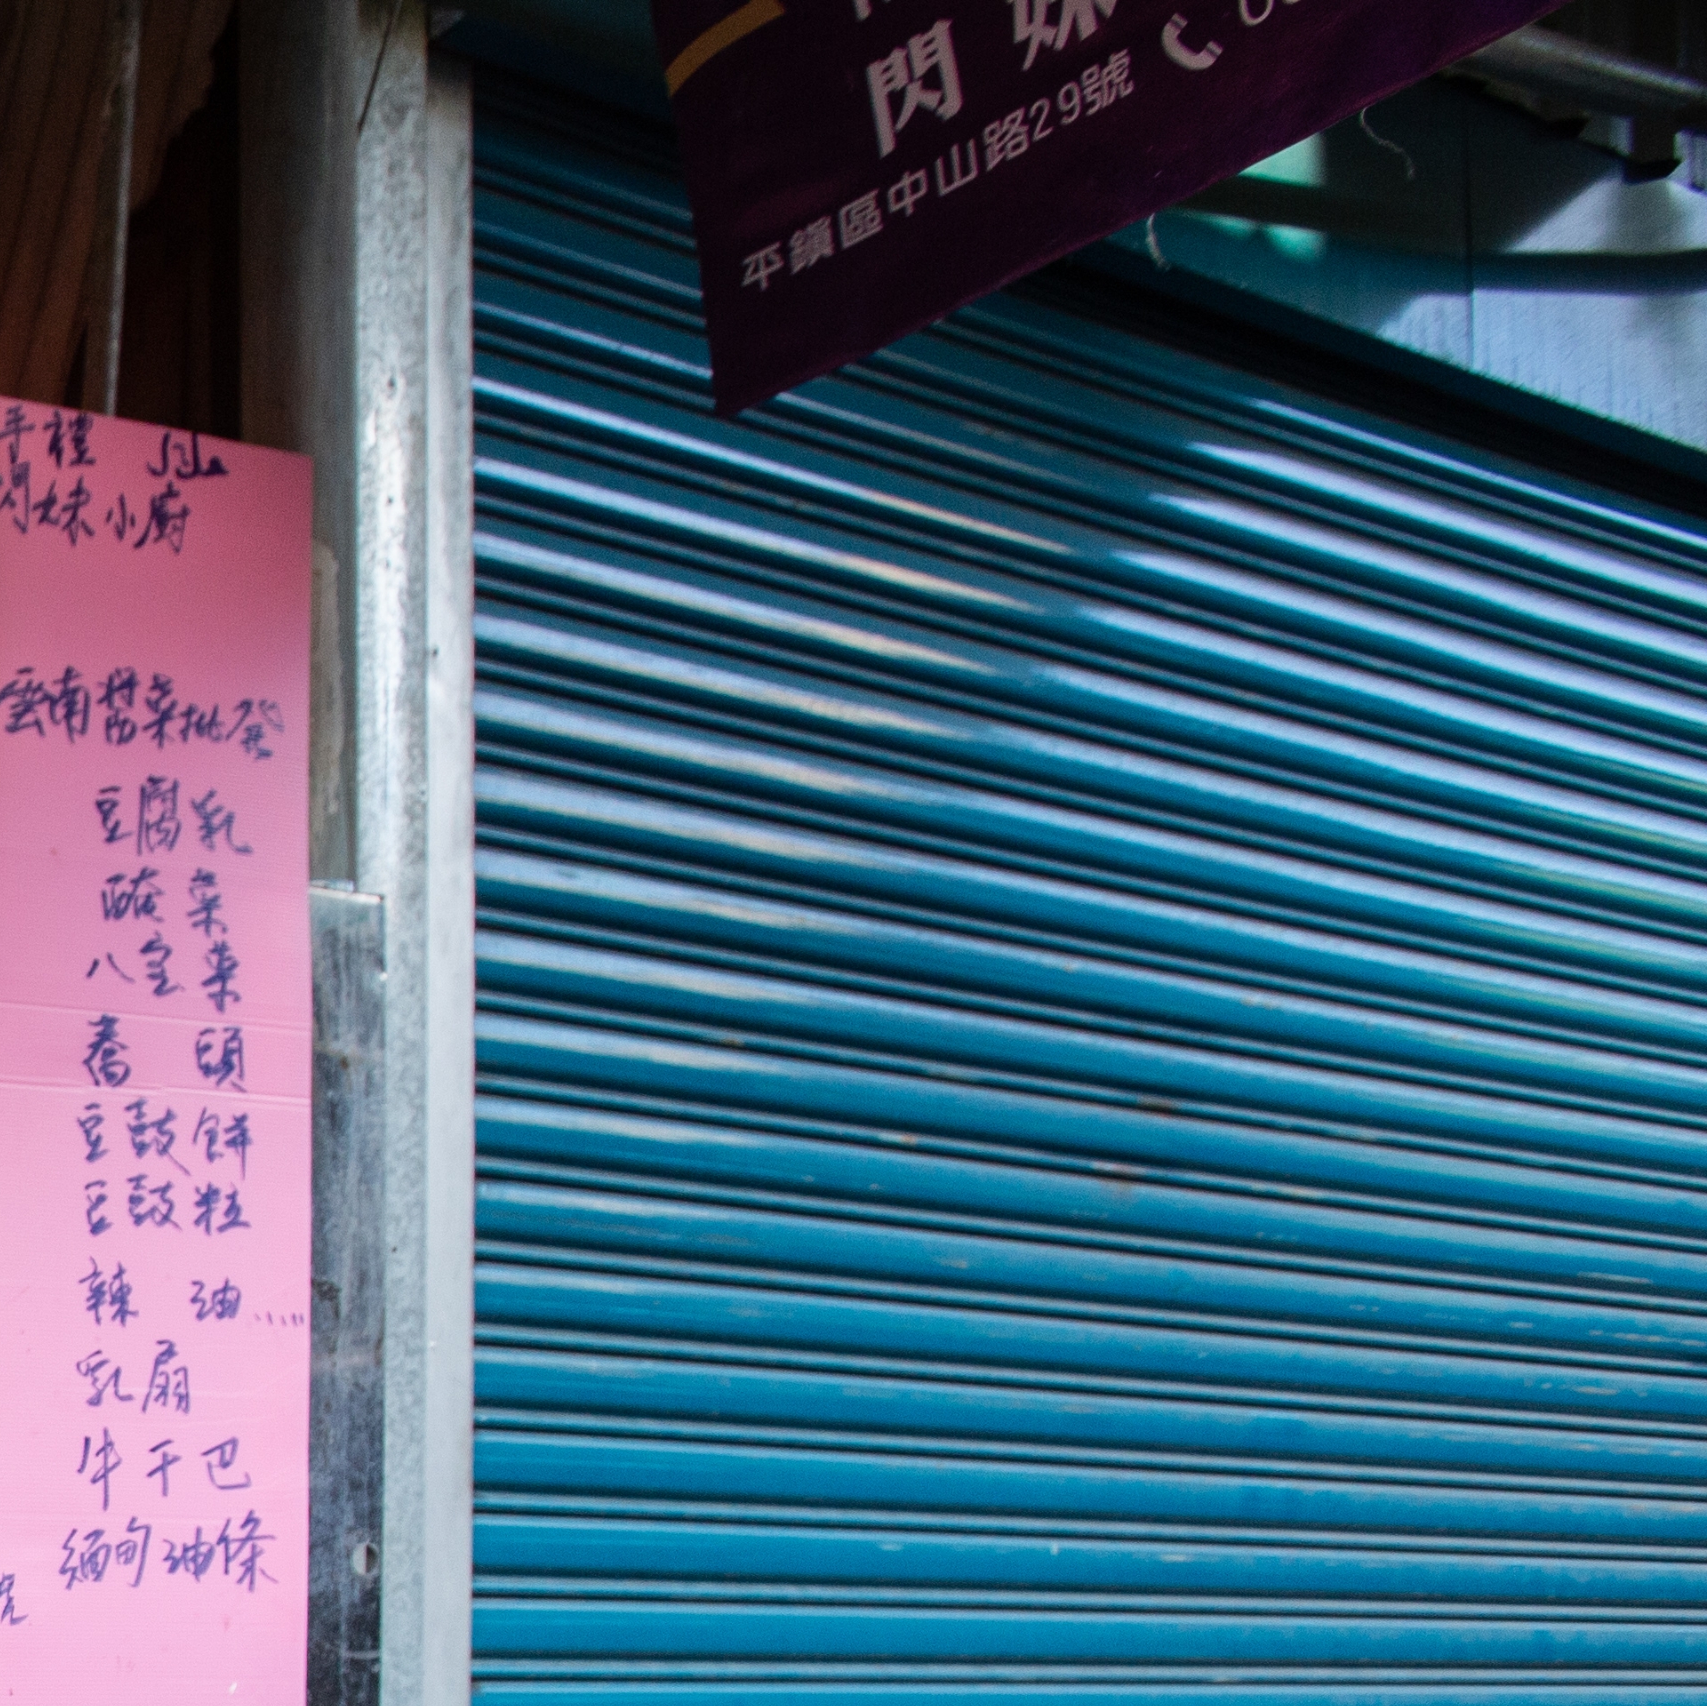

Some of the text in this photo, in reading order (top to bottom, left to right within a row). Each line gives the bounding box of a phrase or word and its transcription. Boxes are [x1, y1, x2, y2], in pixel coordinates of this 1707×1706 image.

[741, 49, 1135, 292] 平鎮區中山路29號
[77, 1428, 251, 1510] 牛干巴
[59, 1509, 279, 1593] 緬甸油條
